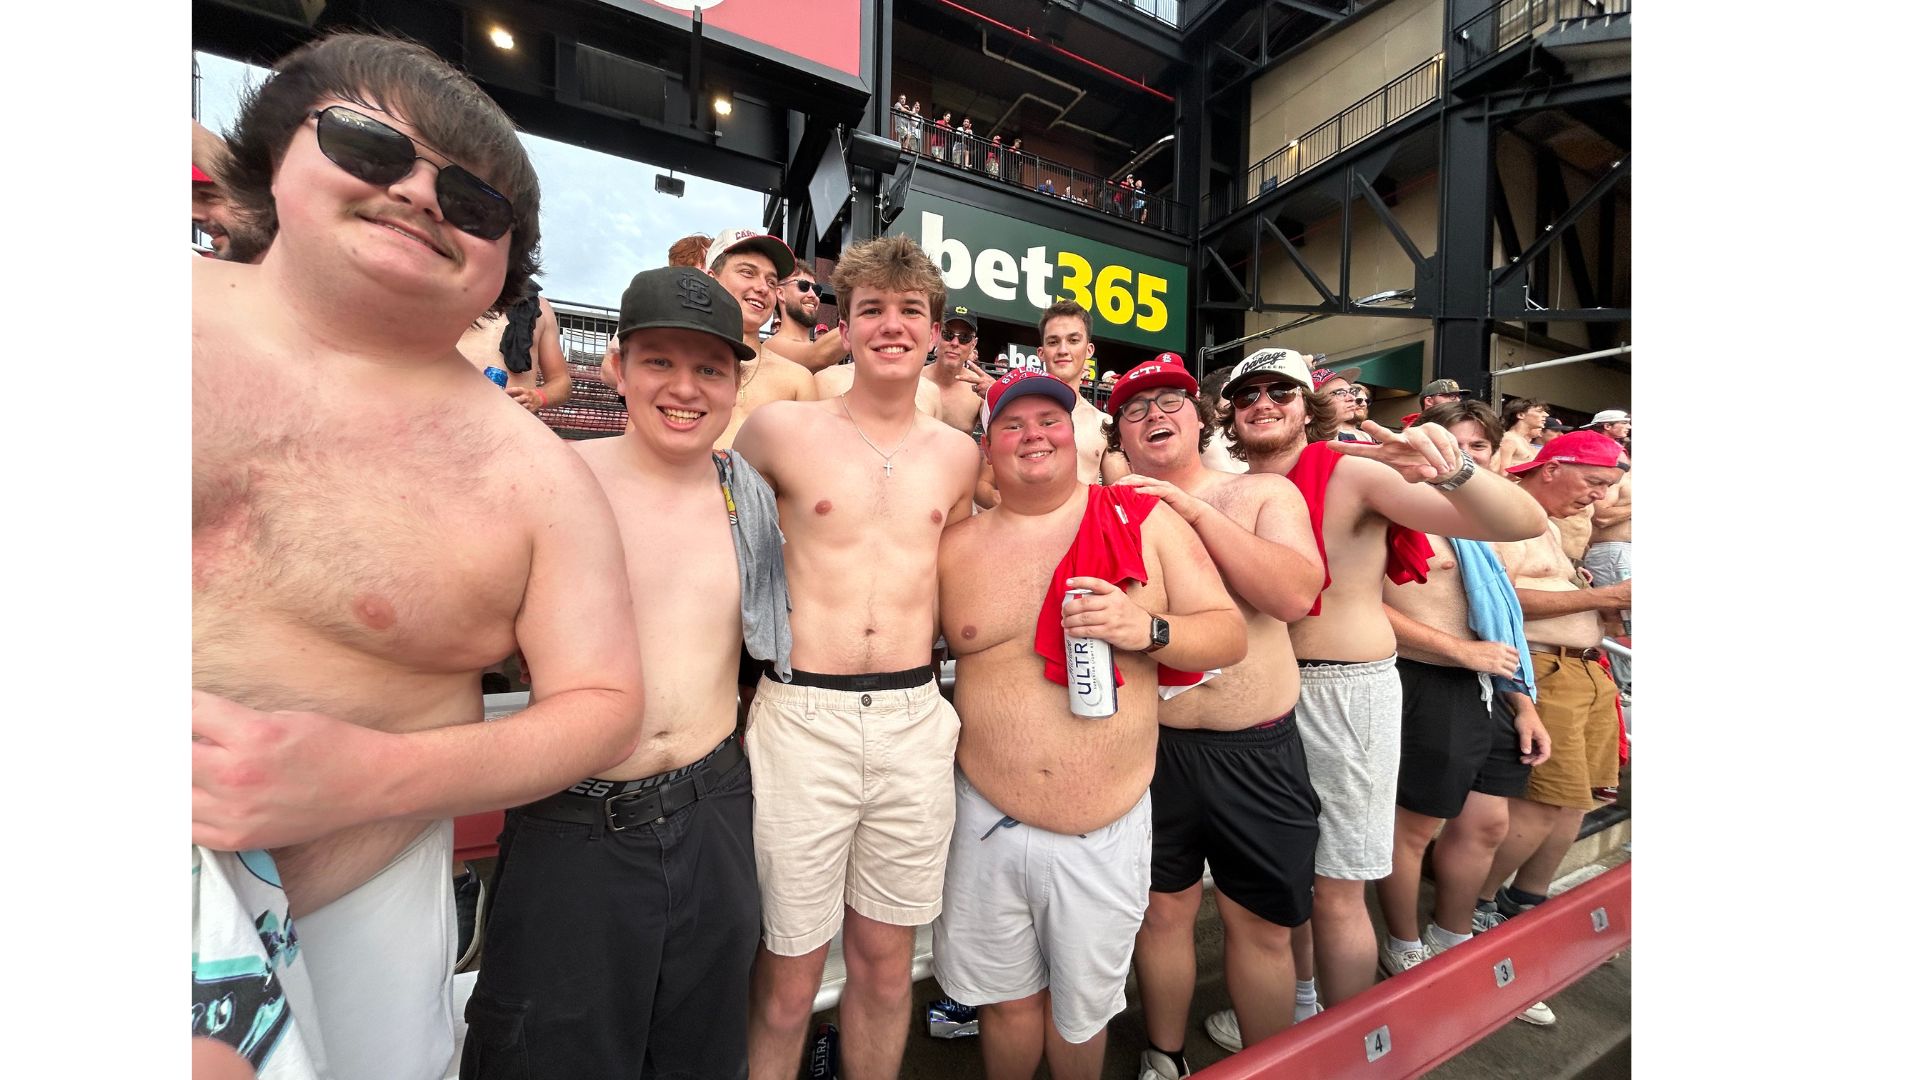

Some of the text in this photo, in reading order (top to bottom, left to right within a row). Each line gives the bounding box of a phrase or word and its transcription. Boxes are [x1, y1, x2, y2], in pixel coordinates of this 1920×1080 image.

[921, 211, 1169, 332] bet365
[1074, 636, 1092, 695] ULTR
[1501, 964, 1509, 982] 3
[813, 1036, 828, 1078] ULTRA
[1374, 1033, 1384, 1054] 4
